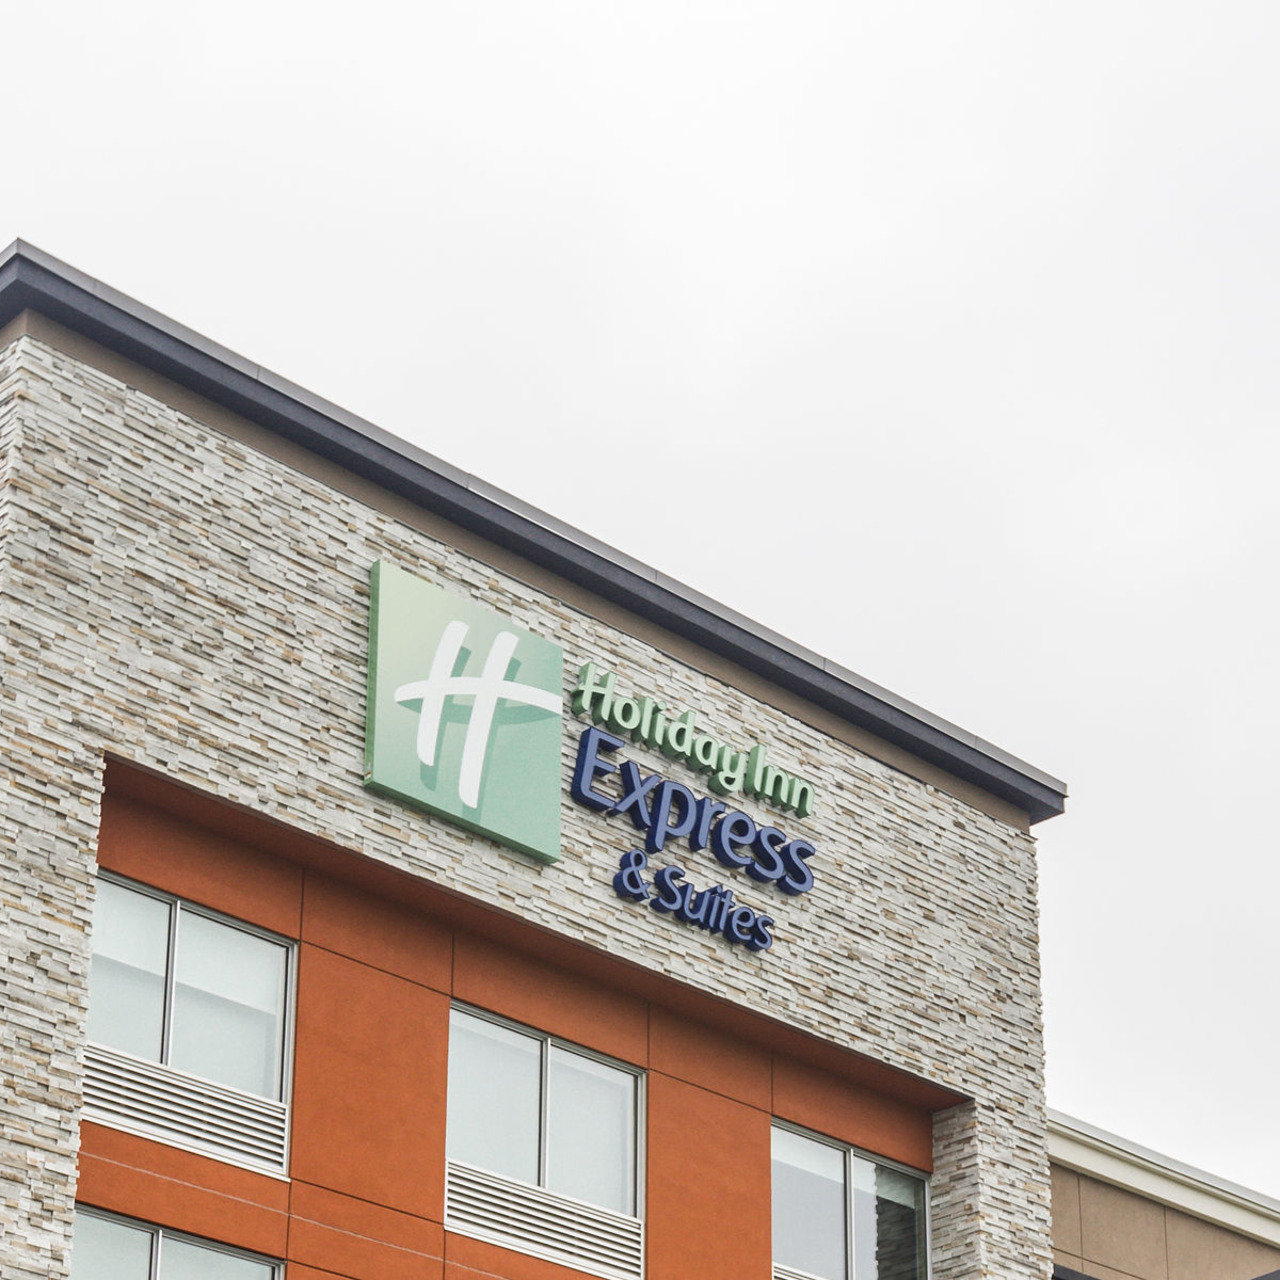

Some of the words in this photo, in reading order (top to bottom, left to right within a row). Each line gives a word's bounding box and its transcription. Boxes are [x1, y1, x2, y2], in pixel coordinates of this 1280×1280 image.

[571, 661, 746, 796] Holiday
[745, 744, 816, 818] Inn
[571, 726, 816, 896] Express
[613, 849, 651, 901] &
[651, 865, 775, 950] Suites
